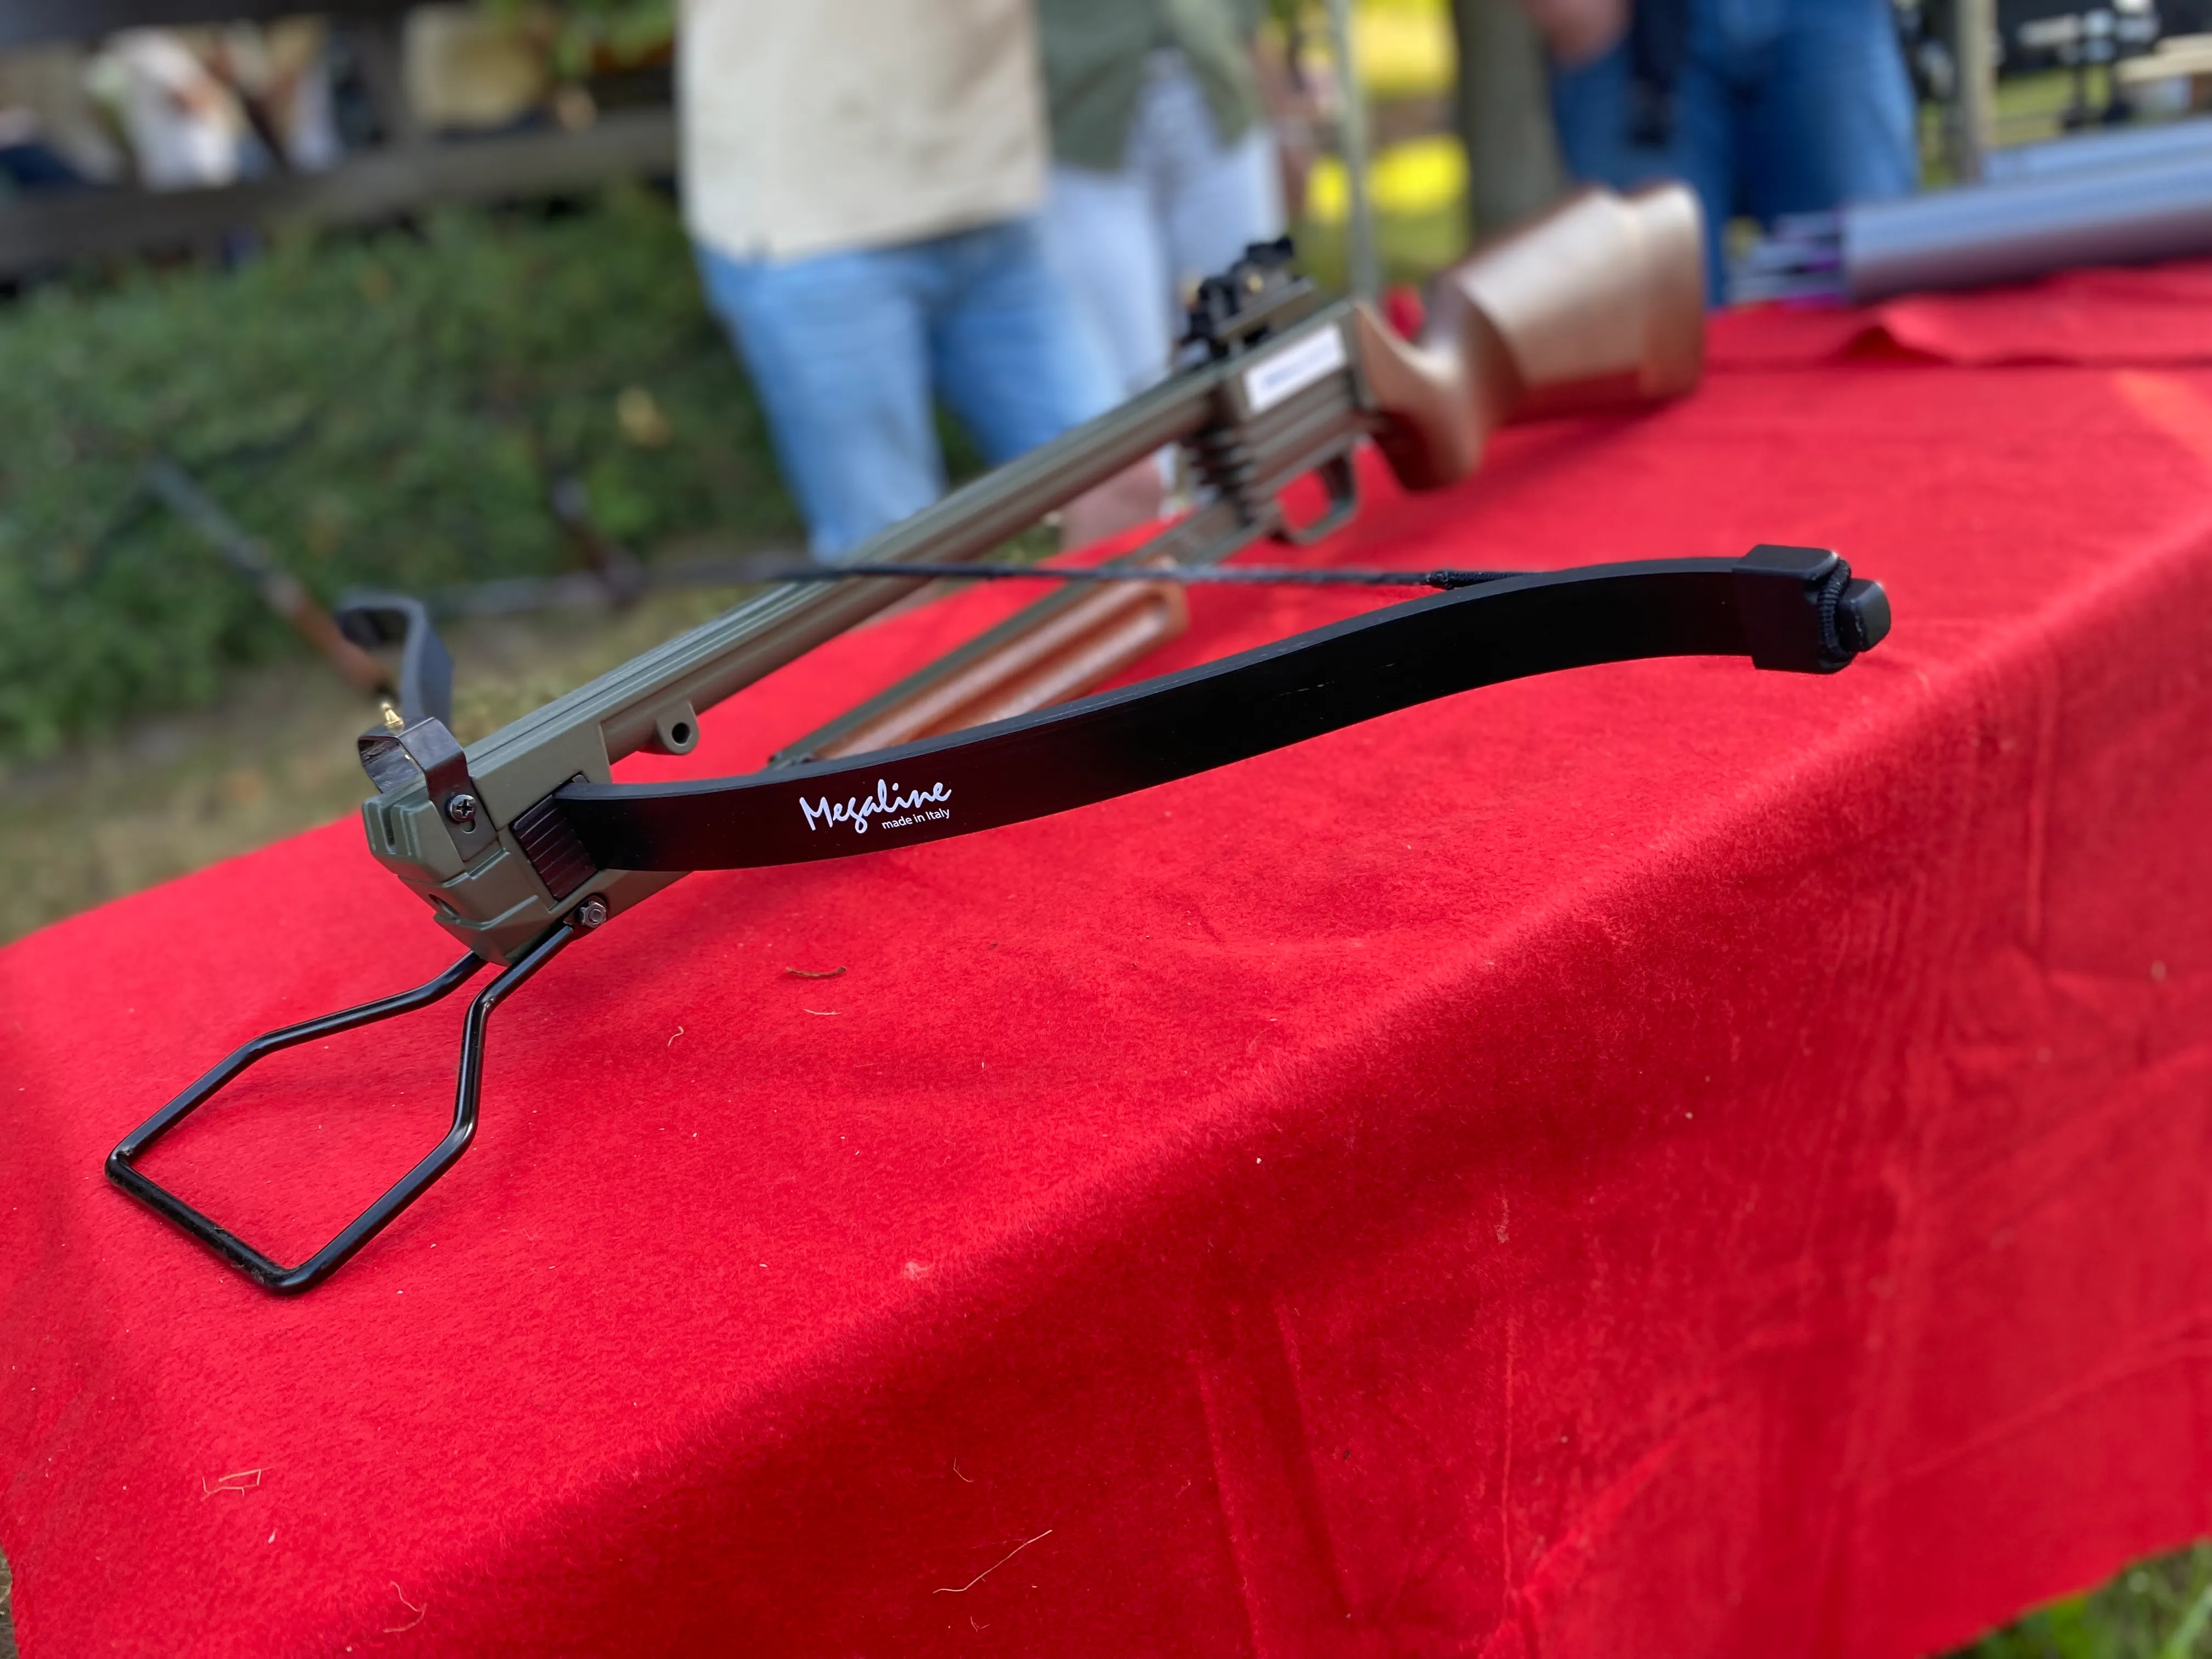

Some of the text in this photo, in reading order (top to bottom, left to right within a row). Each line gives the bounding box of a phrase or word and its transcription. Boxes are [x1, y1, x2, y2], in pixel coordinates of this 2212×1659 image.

[799, 779, 952, 834] Megaline
[882, 808, 950, 830] made in Italy
